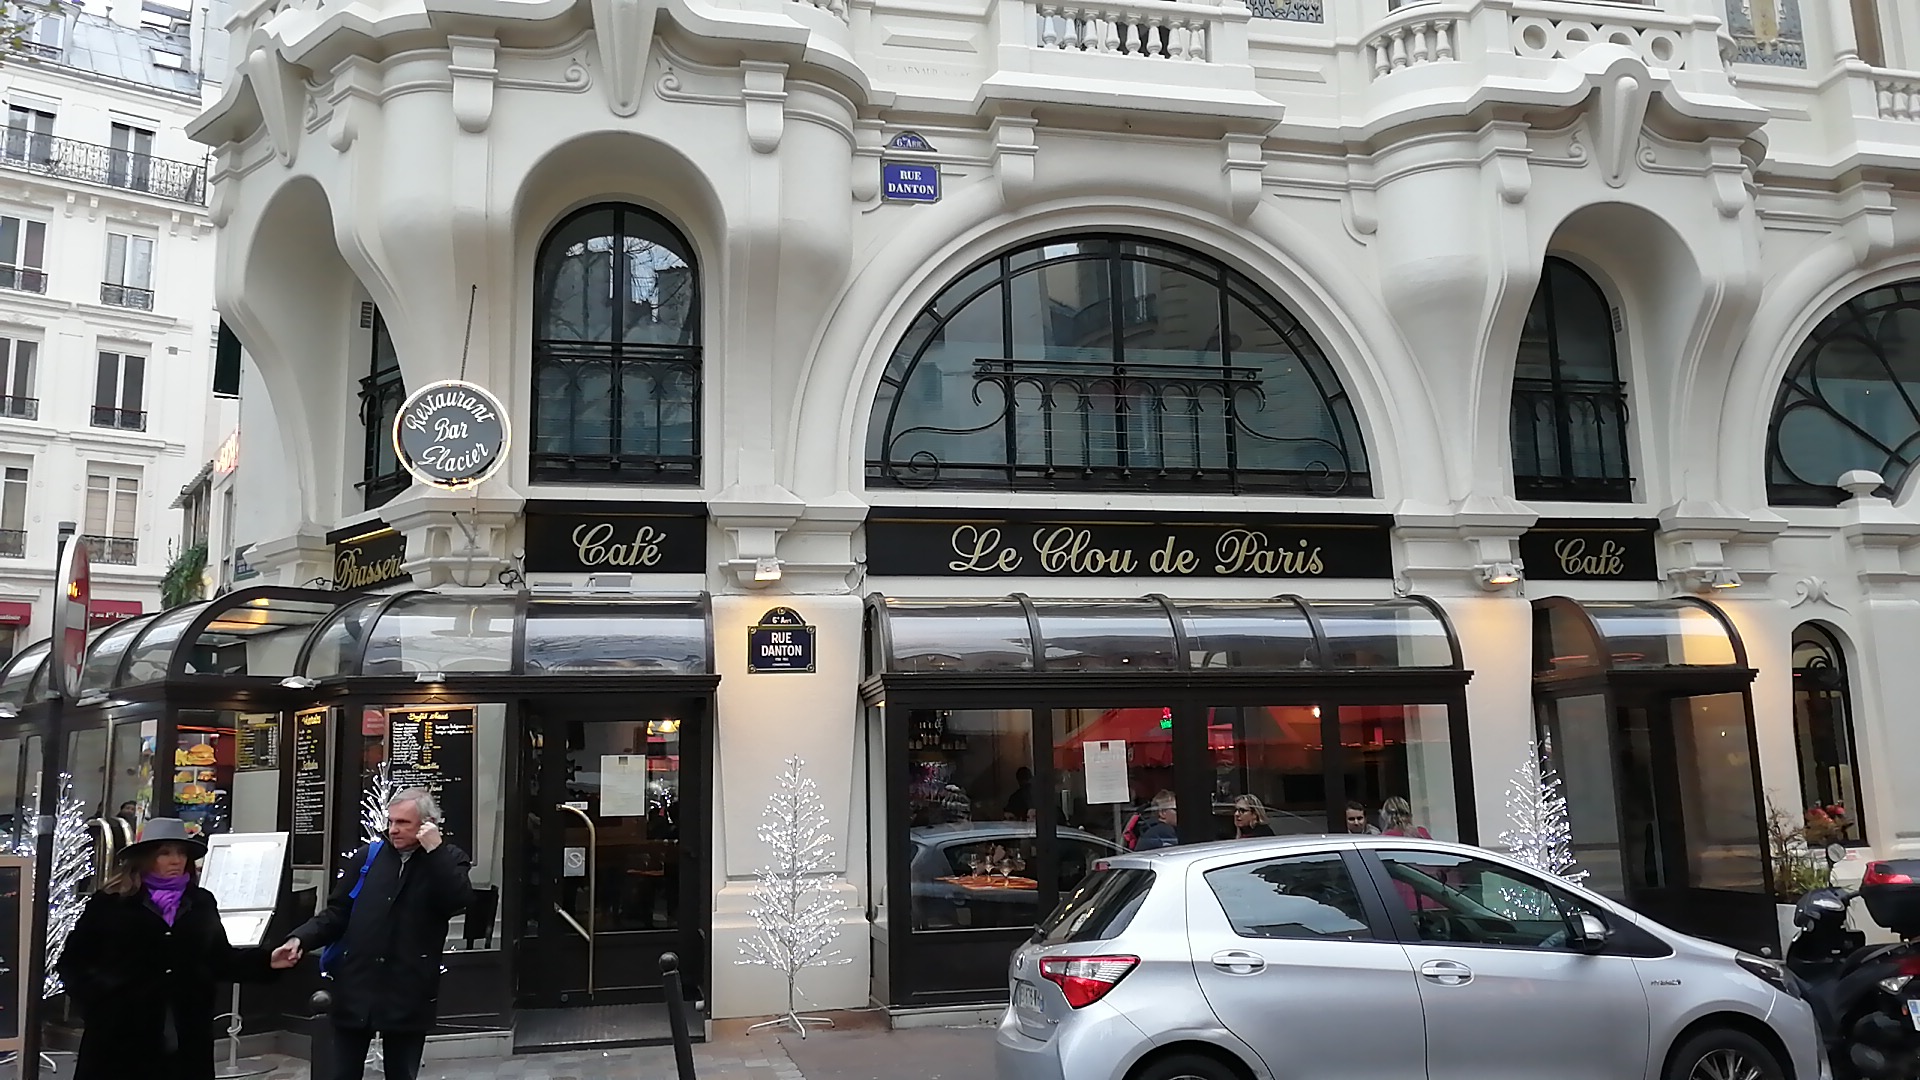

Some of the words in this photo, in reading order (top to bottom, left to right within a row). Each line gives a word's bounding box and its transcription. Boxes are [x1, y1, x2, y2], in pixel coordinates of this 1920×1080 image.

[888, 183, 935, 195] DANTON
[900, 170, 922, 181] RUE
[405, 391, 495, 433] Restaurant
[434, 417, 469, 443] Bar
[418, 442, 489, 472] Glacier
[572, 523, 667, 567] Café
[949, 525, 1023, 572] Le
[1032, 527, 1138, 573] Clou
[1149, 536, 1200, 574] de
[1214, 529, 1324, 575] Paris
[1554, 538, 1626, 575] Café
[761, 645, 802, 656] DANTON
[771, 632, 792, 643] RUE
